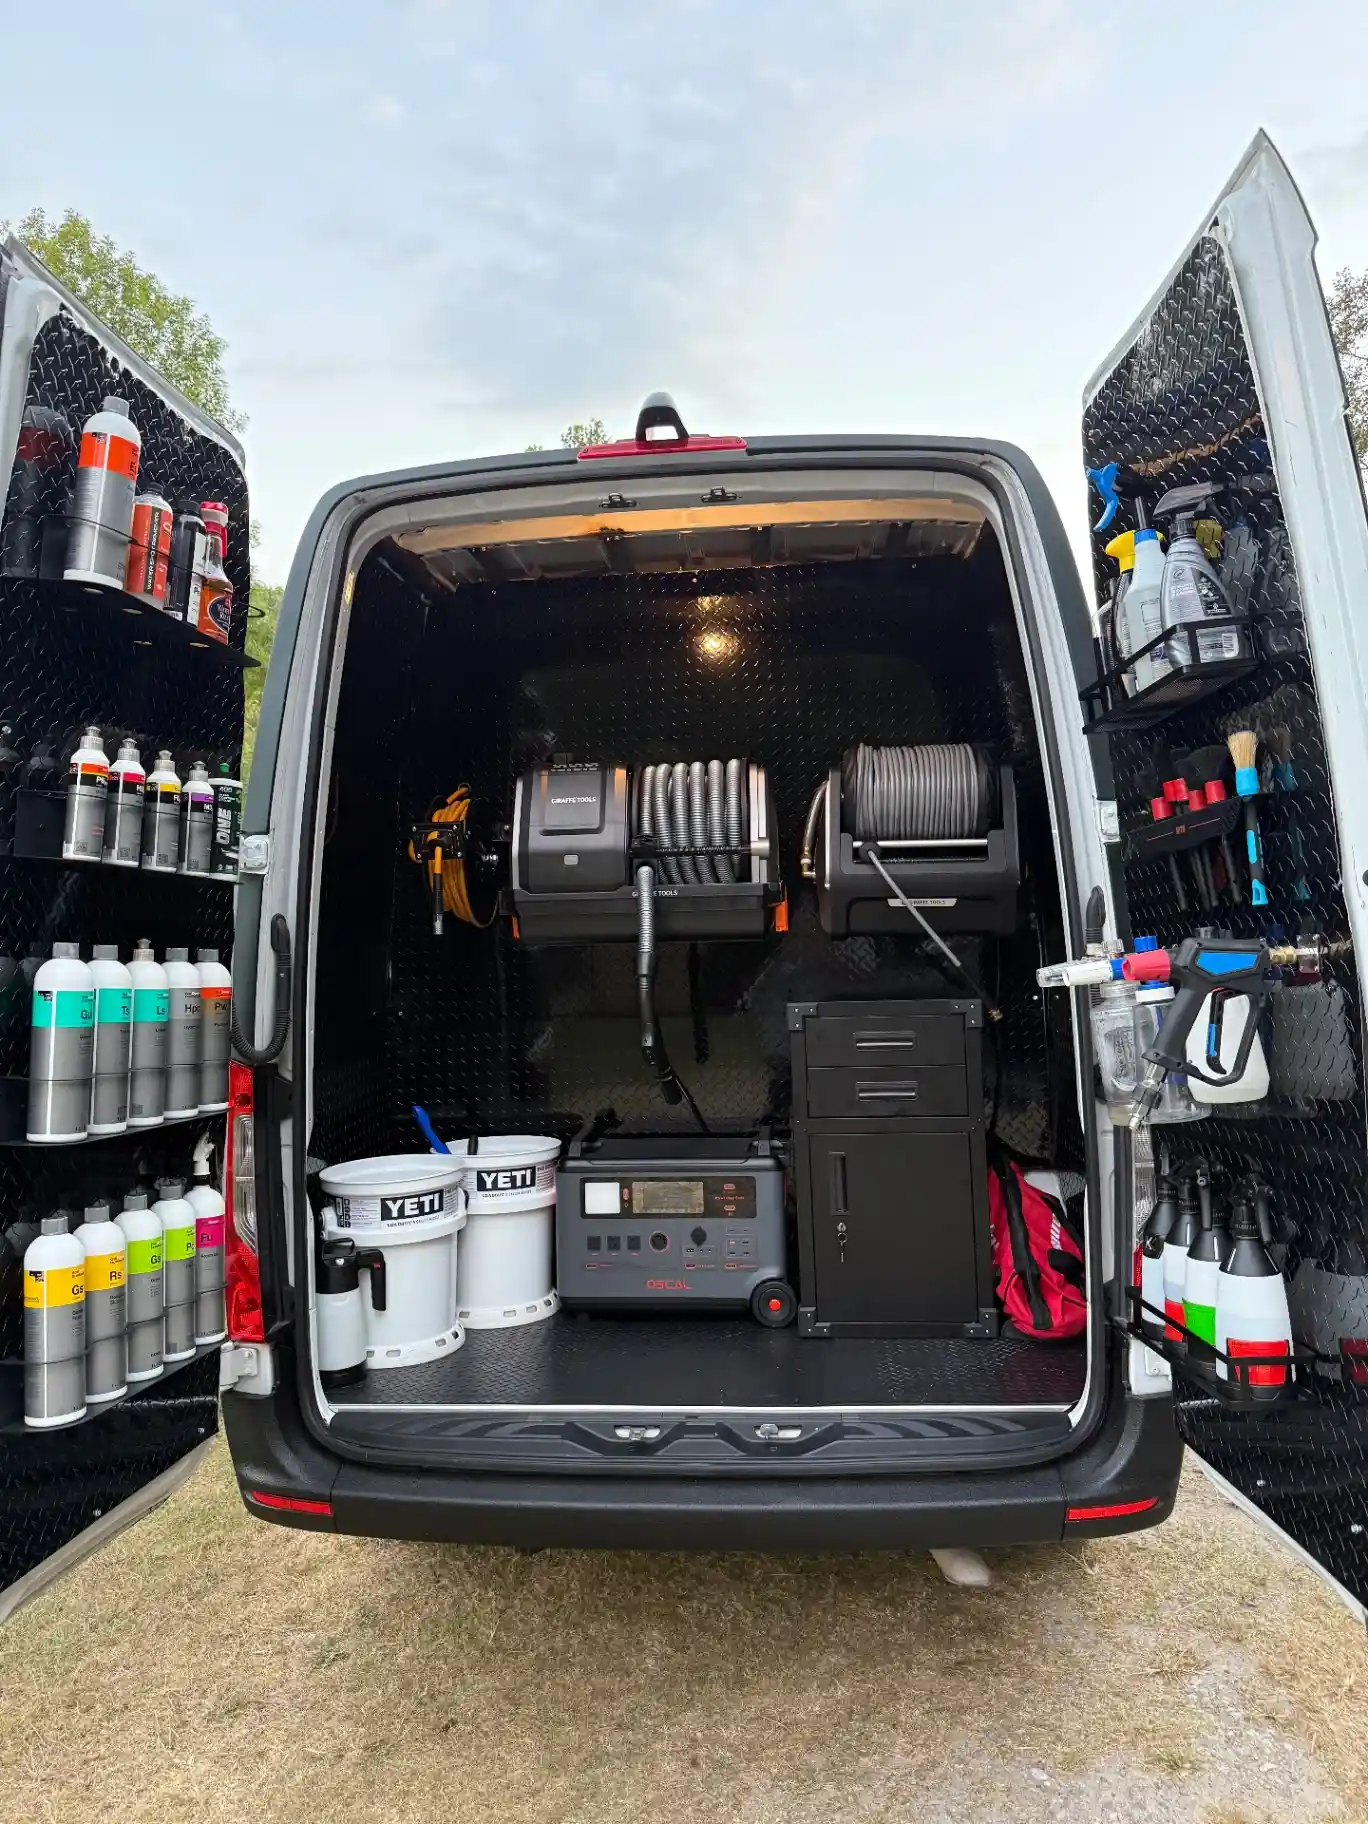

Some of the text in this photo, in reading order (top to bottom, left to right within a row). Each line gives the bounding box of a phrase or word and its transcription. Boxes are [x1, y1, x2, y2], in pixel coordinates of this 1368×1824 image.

[216, 807, 232, 845] ONE
[480, 1168, 532, 1189] YETI
[385, 1193, 440, 1218] YETI
[646, 1279, 693, 1290] OSCAL
